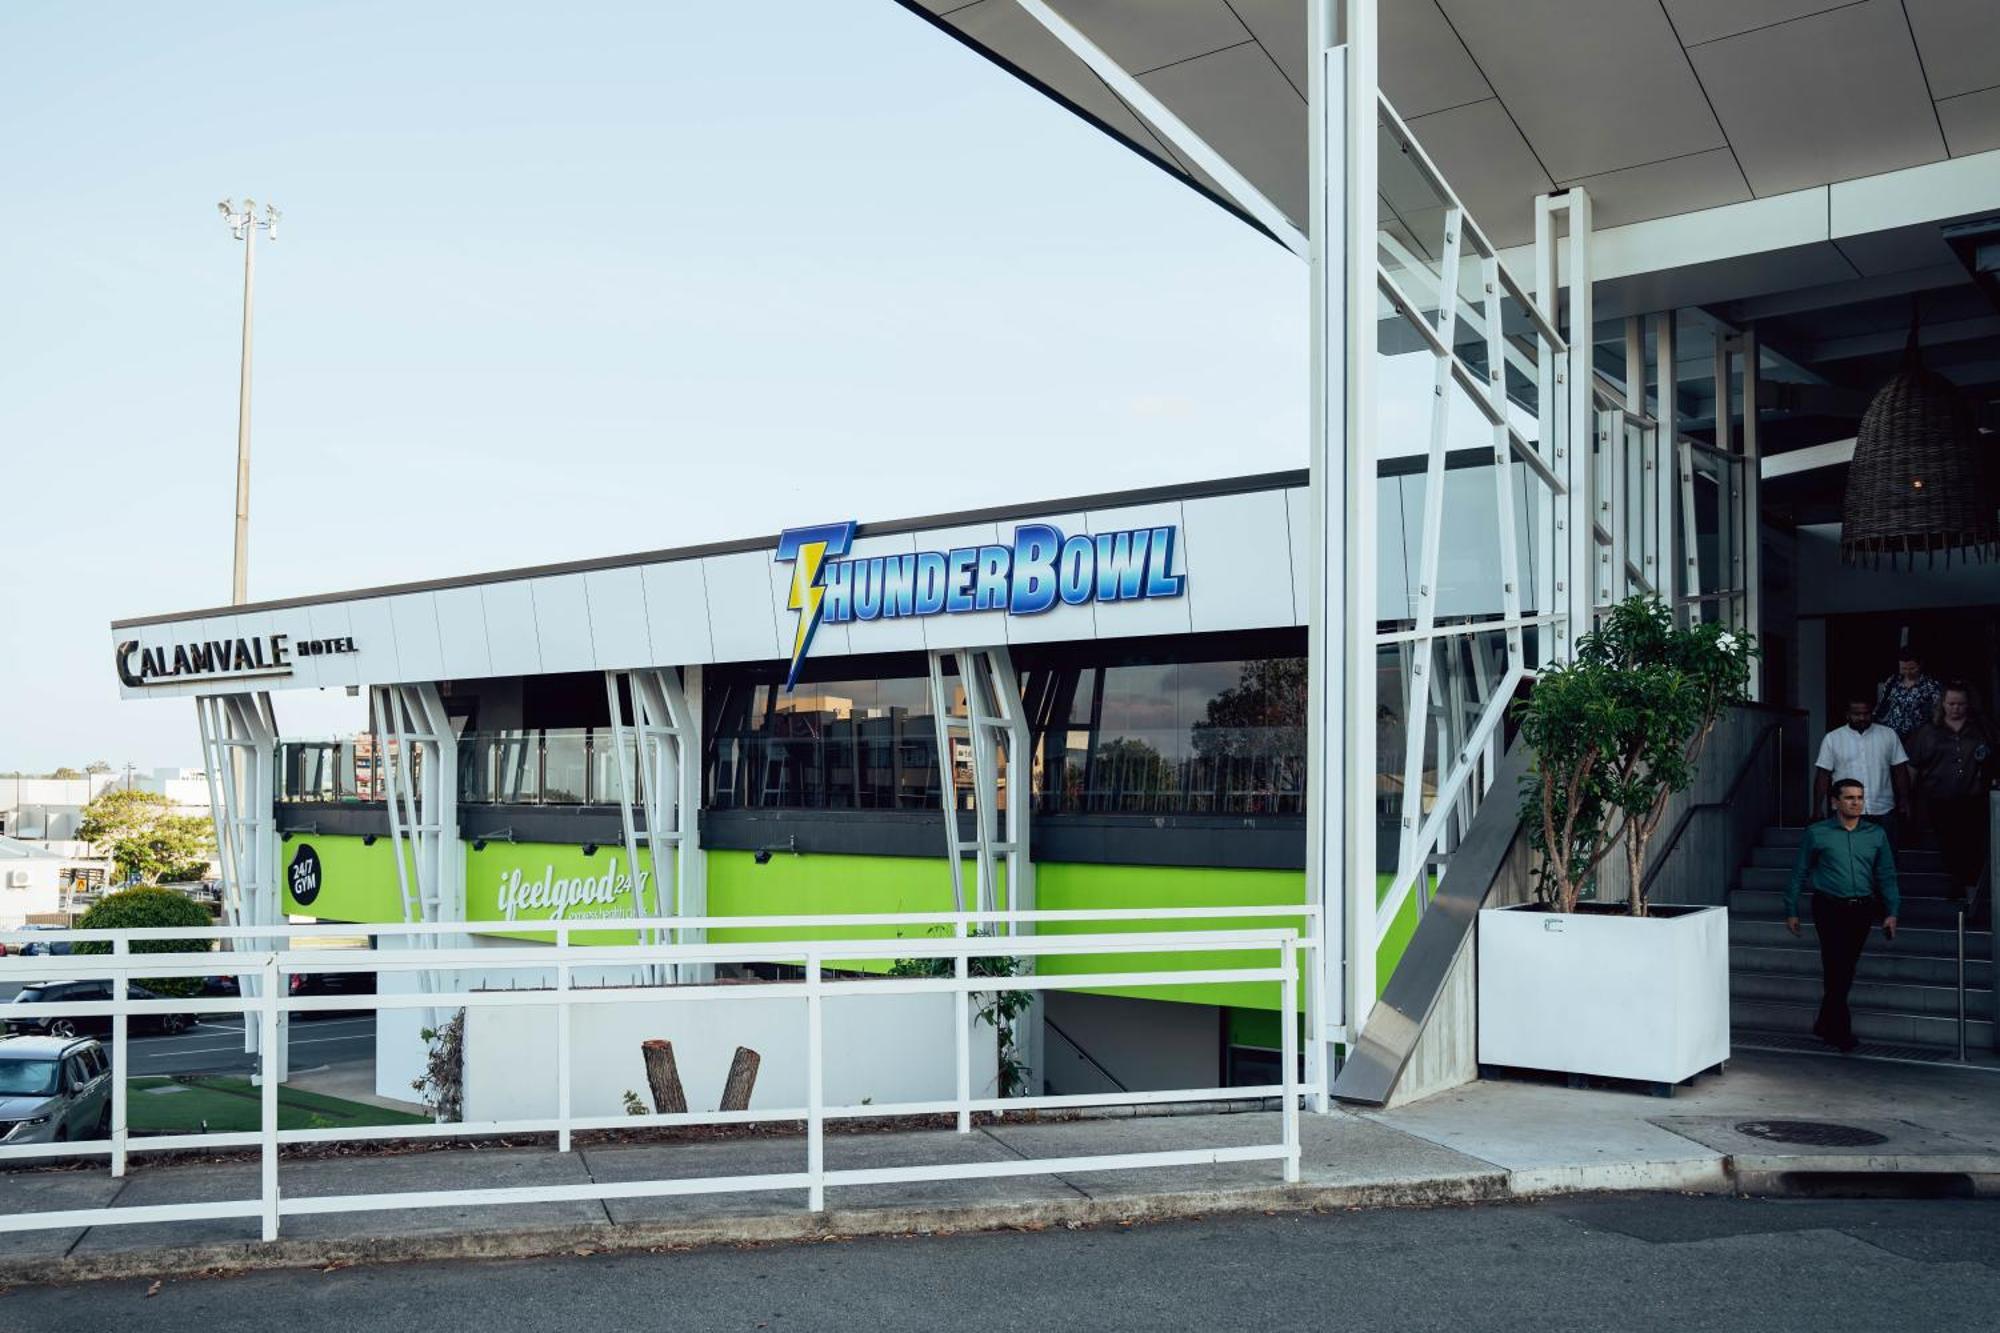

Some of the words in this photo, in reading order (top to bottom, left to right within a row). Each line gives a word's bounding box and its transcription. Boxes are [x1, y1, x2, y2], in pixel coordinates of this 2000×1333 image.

[116, 634, 293, 687] CALAMVALE
[297, 637, 359, 656] HOTEL
[293, 858, 313, 880] 24/7
[295, 873, 316, 894] GYM
[498, 857, 617, 921] ifeelgood
